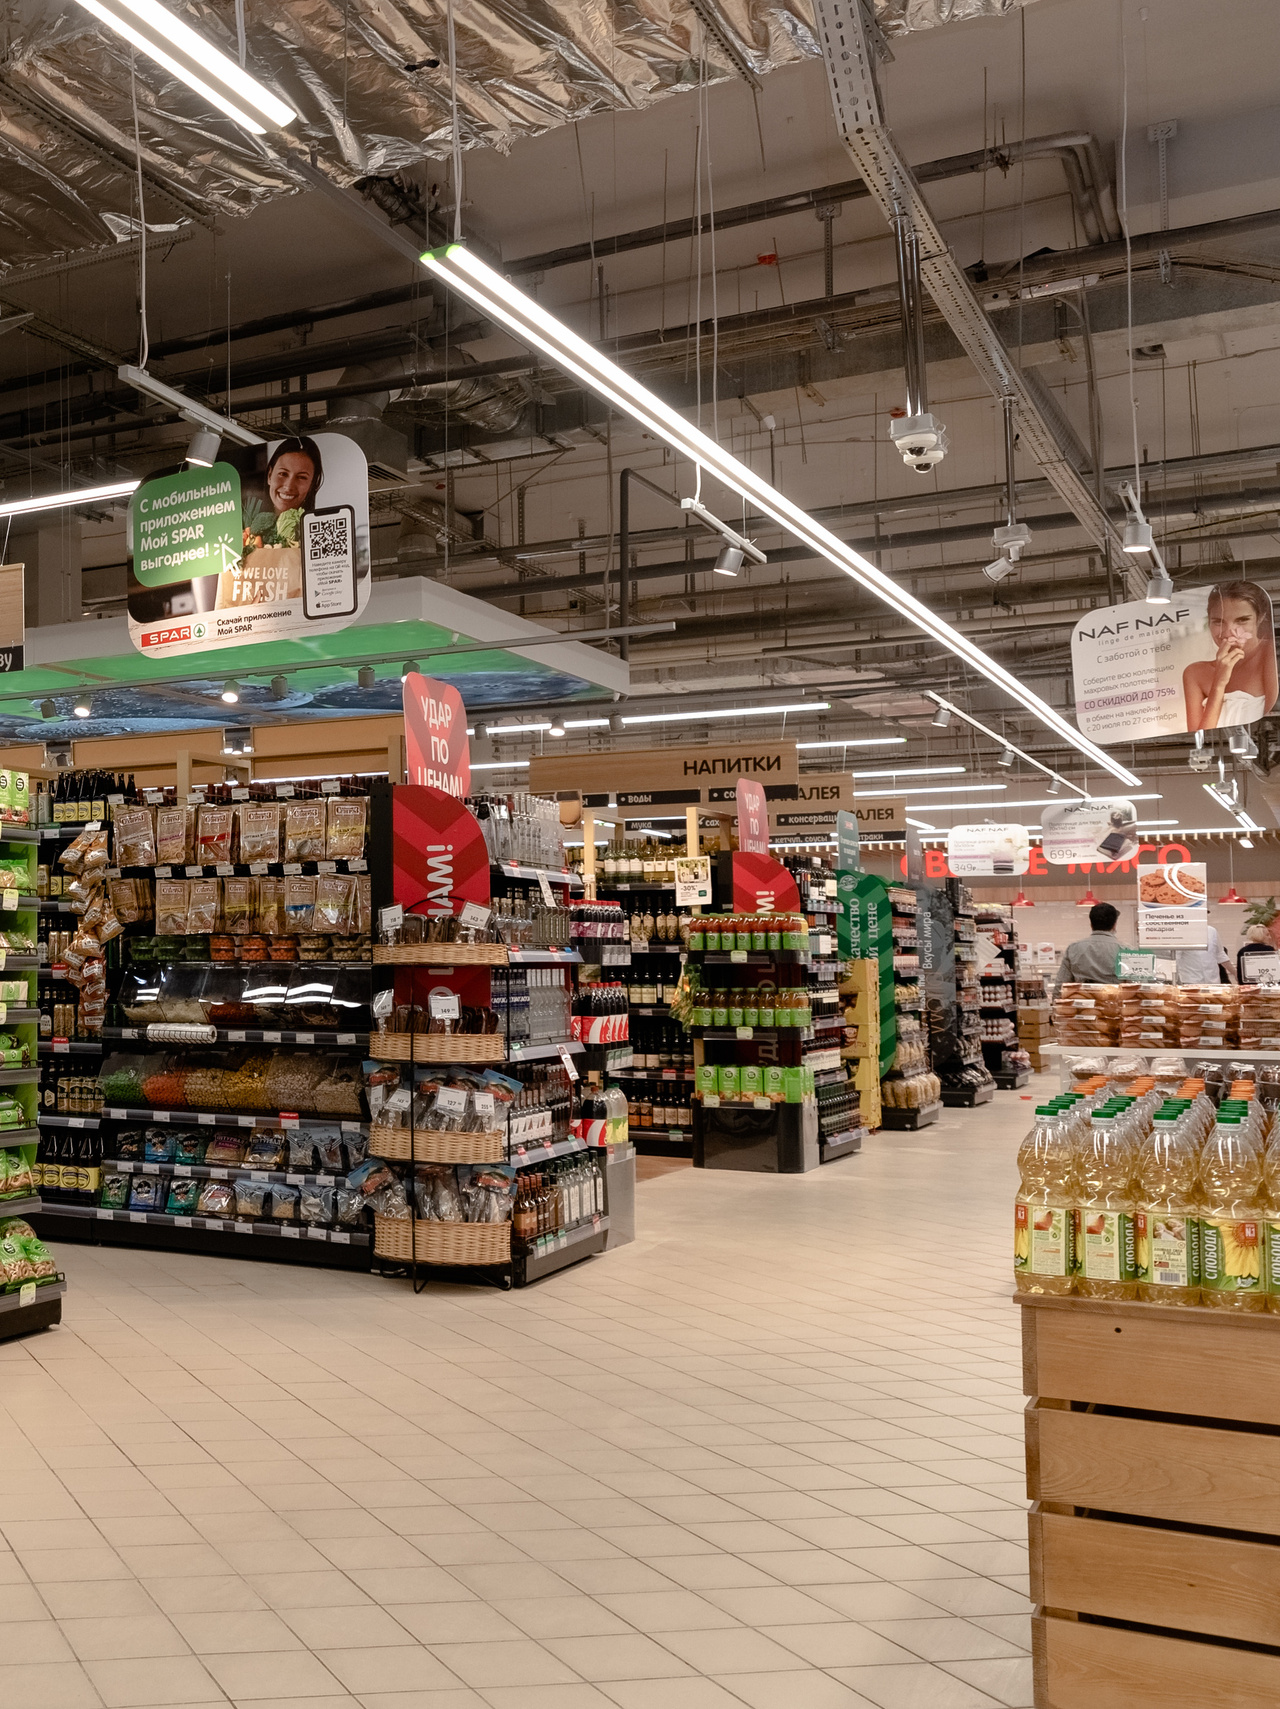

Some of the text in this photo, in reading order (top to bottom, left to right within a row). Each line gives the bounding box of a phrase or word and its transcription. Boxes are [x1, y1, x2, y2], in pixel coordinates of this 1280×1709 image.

[140, 480, 232, 513] С мобильным
[140, 500, 236, 534] приложением
[140, 524, 205, 552] Мой SPAR
[140, 542, 210, 571] выгоднее!
[262, 567, 289, 580] LOVE
[216, 610, 292, 628] Скачай приложение
[1078, 608, 1190, 642] NAF NAF
[149, 627, 191, 645] SPAR
[217, 624, 253, 636] Мой SPAR
[1098, 637, 1120, 646] linge
[1139, 628, 1172, 638] maison
[1096, 643, 1172, 664] С заботой о тебе
[1082, 664, 1175, 686] Соберите всю коллекцию
[1083, 677, 1160, 696] махровых полотенец
[1084, 687, 1176, 710] СО СКИДКОЙ ДО 75%
[420, 695, 452, 730] УДАР
[1092, 712, 1114, 722] обмен
[1126, 706, 1161, 716] наклейки
[1092, 723, 1101, 732] 20
[1102, 720, 1121, 730] июля
[1132, 716, 1141, 726] 27
[1142, 712, 1178, 724] сентября
[431, 736, 450, 765] ПО
[683, 755, 782, 776] НАПИТКИ
[628, 794, 652, 804] воды
[744, 792, 760, 814] УДАР
[631, 821, 652, 830] мука
[750, 818, 760, 836] ПО
[804, 835, 828, 843] соусы
[426, 844, 454, 918] НАМ!
[867, 902, 879, 940] цене
[922, 911, 934, 969] Вкусы мира
[1204, 1228, 1218, 1280] СЛОБОДА
